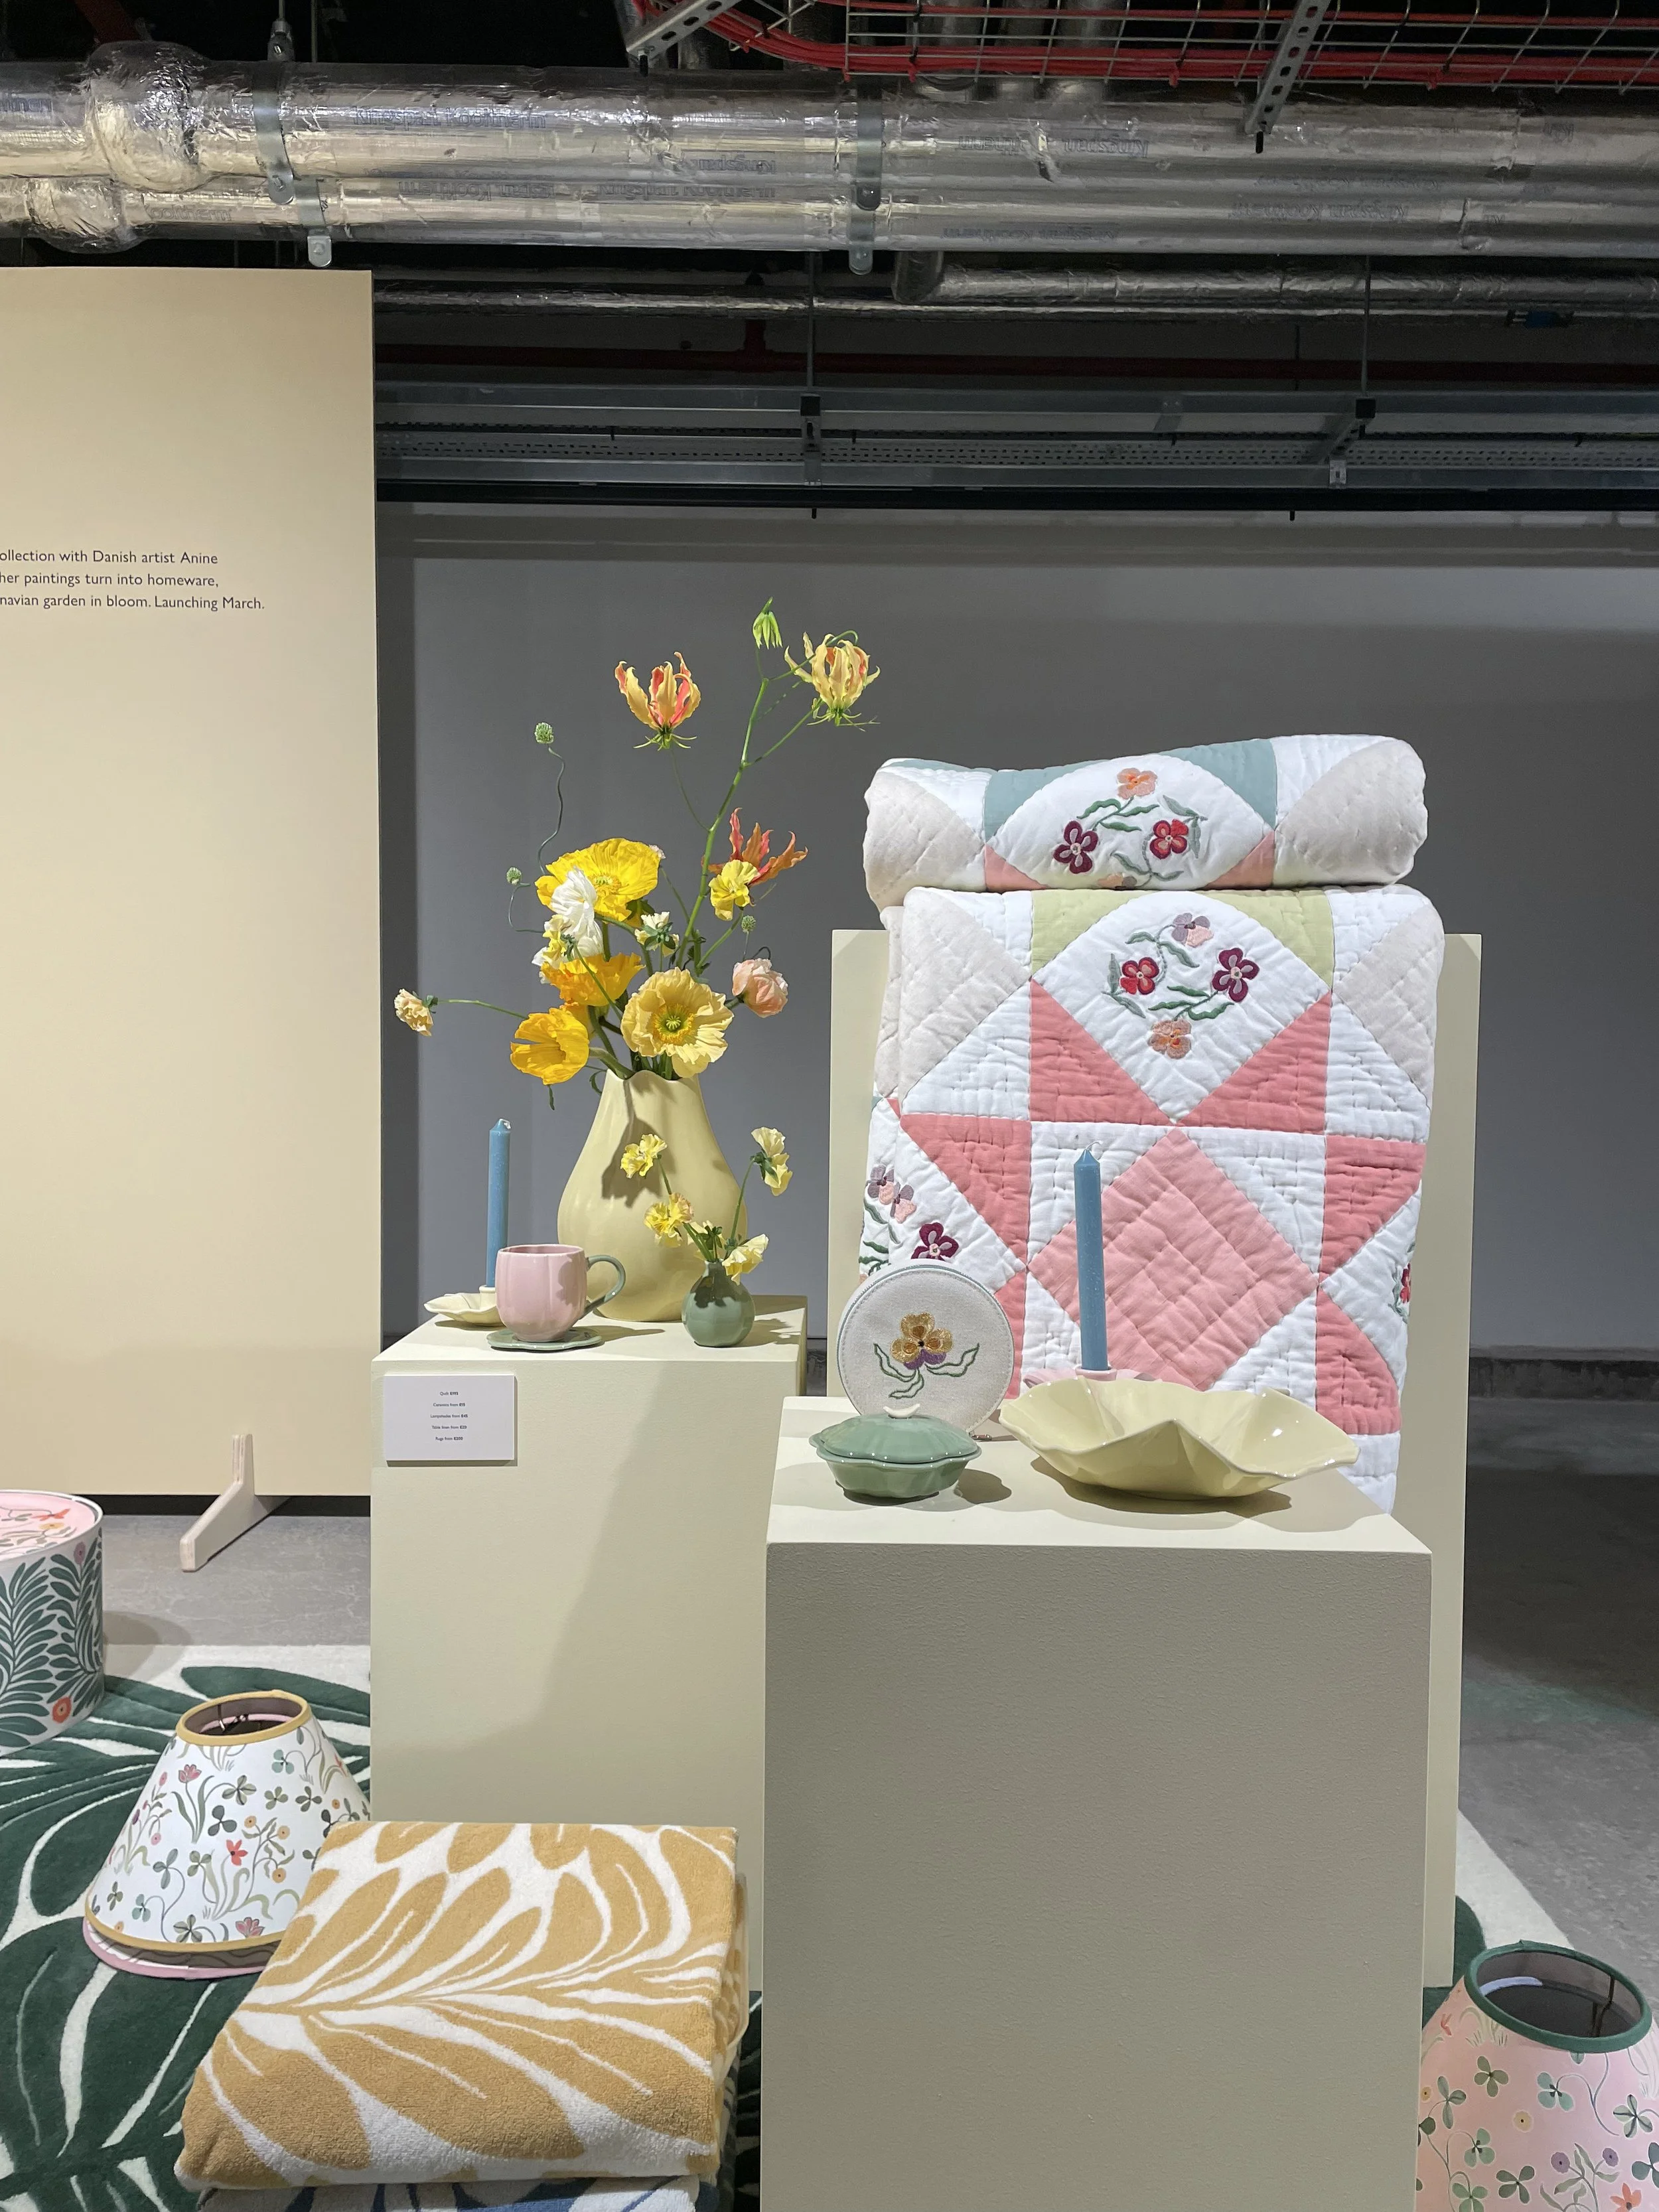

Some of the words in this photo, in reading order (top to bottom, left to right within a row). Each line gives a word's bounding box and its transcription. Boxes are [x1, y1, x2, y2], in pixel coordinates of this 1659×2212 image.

[59, 550, 88, 562] with
[93, 550, 137, 563] Danish
[141, 552, 175, 563] artist
[180, 552, 218, 564] Anine
[0, 571, 19, 583] her
[25, 572, 80, 587] paintings
[85, 573, 112, 585] turn
[117, 573, 143, 585] into
[147, 573, 219, 587] homeware,
[43, 594, 86, 609] garden
[90, 595, 102, 607] in
[106, 595, 151, 608] bloom.
[155, 595, 218, 612] Launching
[222, 597, 265, 609] March.
